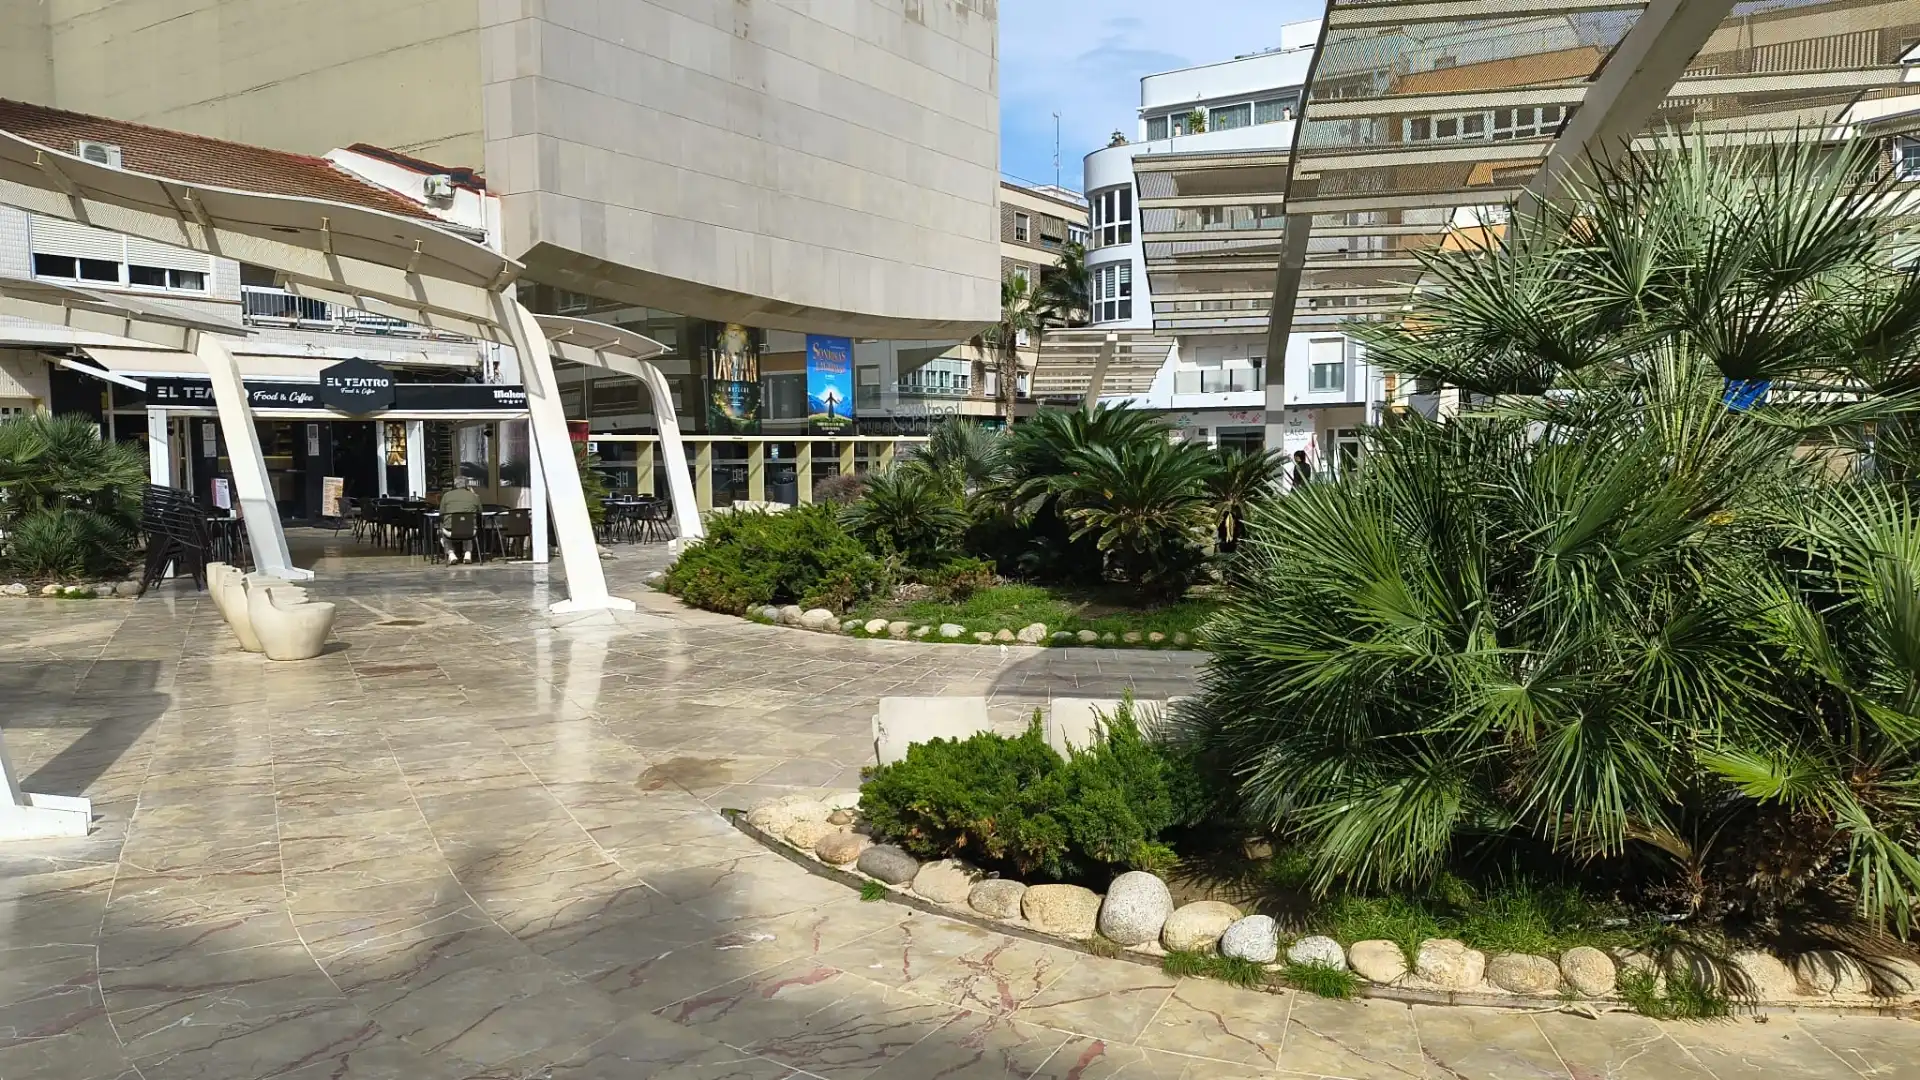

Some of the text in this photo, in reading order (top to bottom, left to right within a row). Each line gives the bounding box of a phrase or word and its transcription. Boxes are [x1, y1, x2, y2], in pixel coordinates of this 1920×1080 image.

[326, 377, 389, 388] EL TEATRO
[157, 386, 179, 398] EL
[182, 387, 250, 399] TEA
[253, 390, 279, 401] Food
[289, 391, 314, 404] Coffee
